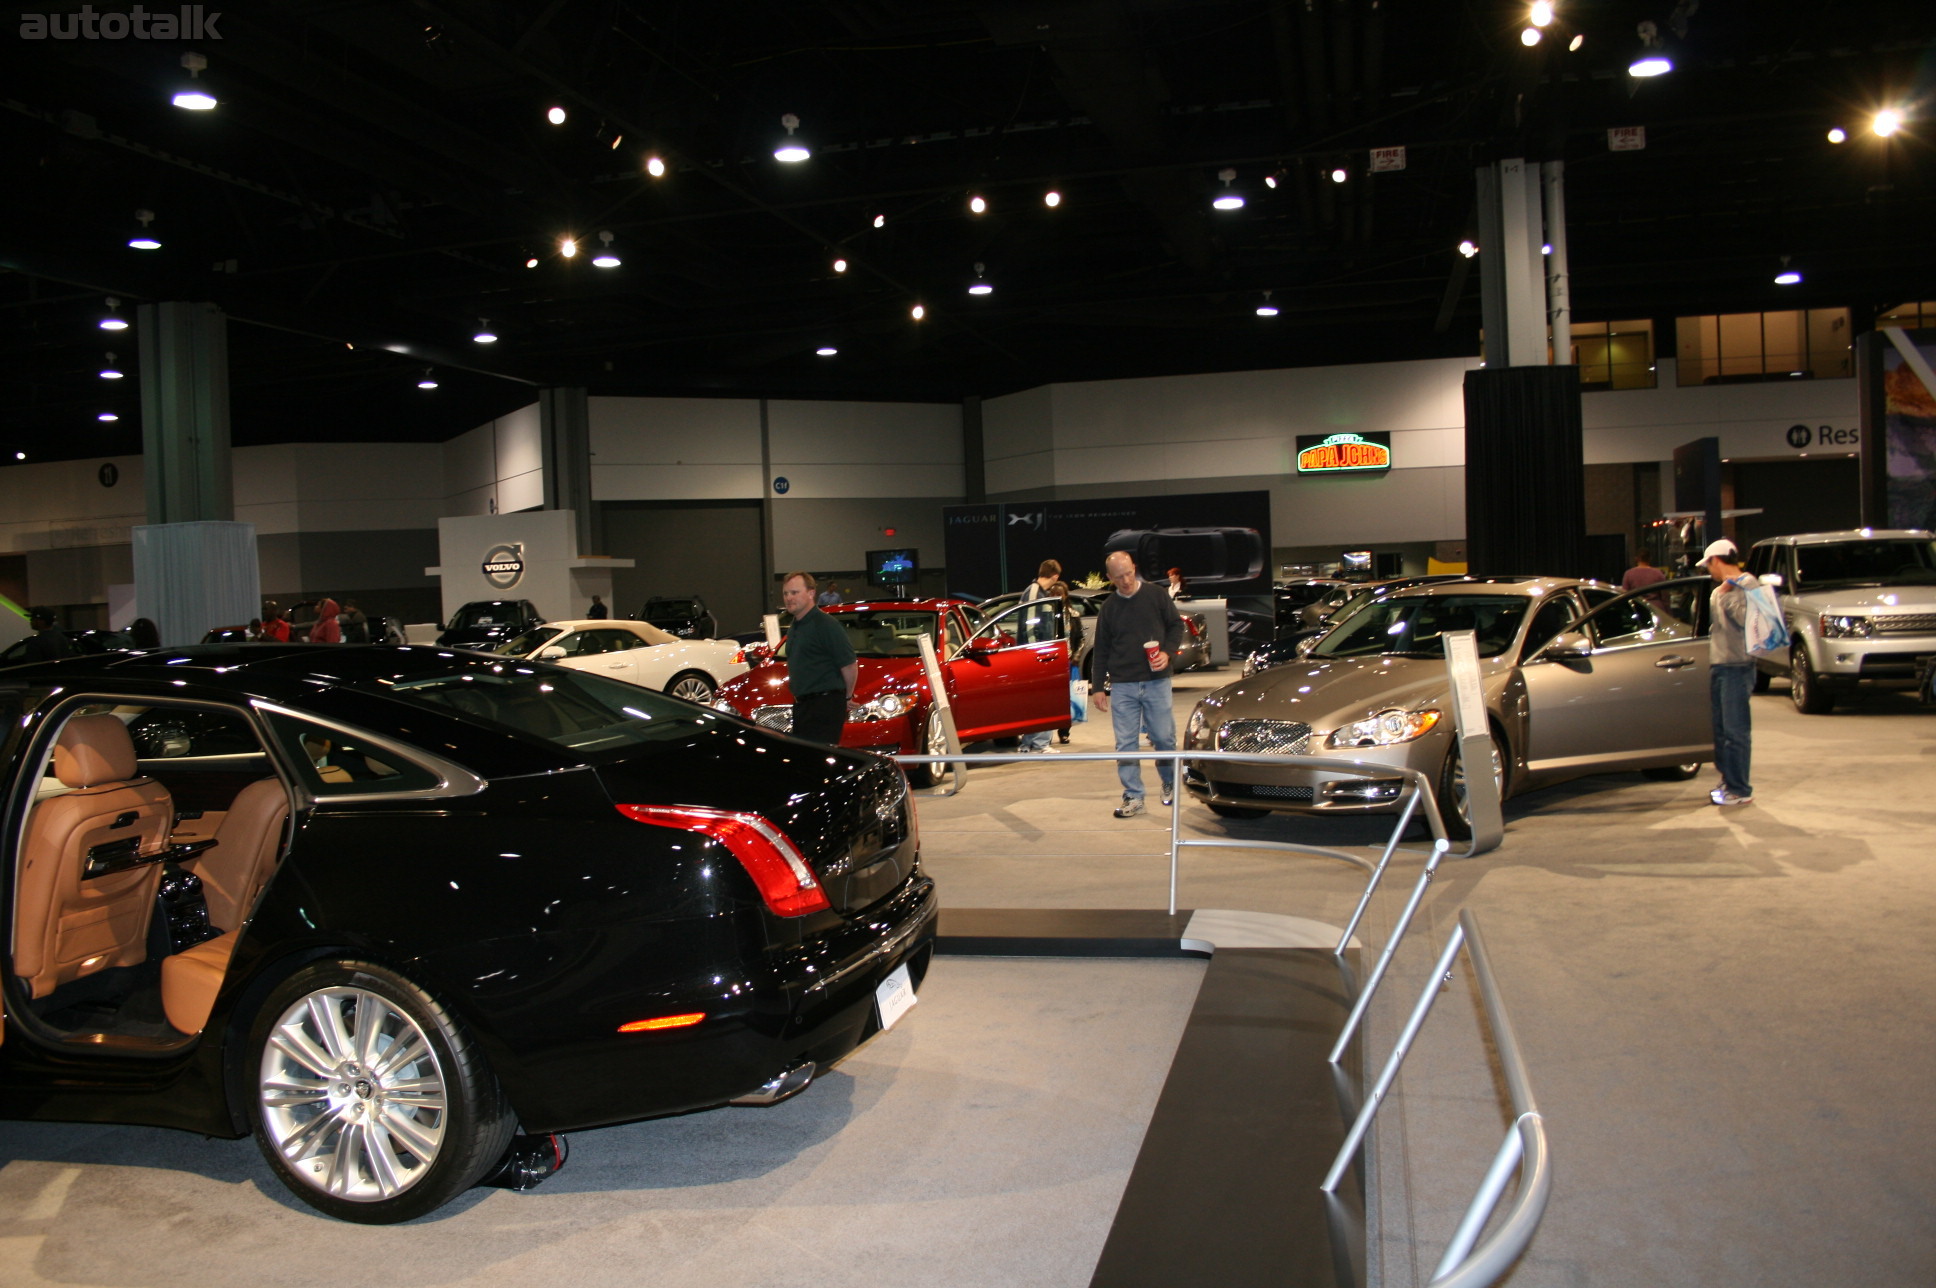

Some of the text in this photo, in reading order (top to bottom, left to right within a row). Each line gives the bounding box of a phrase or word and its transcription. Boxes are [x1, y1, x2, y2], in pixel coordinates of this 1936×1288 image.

[1614, 129, 1637, 137] FIRE
[1376, 150, 1399, 158] FIRE
[1819, 425, 1859, 445] Res
[1300, 445, 1339, 469] PAPA
[950, 514, 997, 527] JAGUAR
[484, 563, 521, 572] VOLVO
